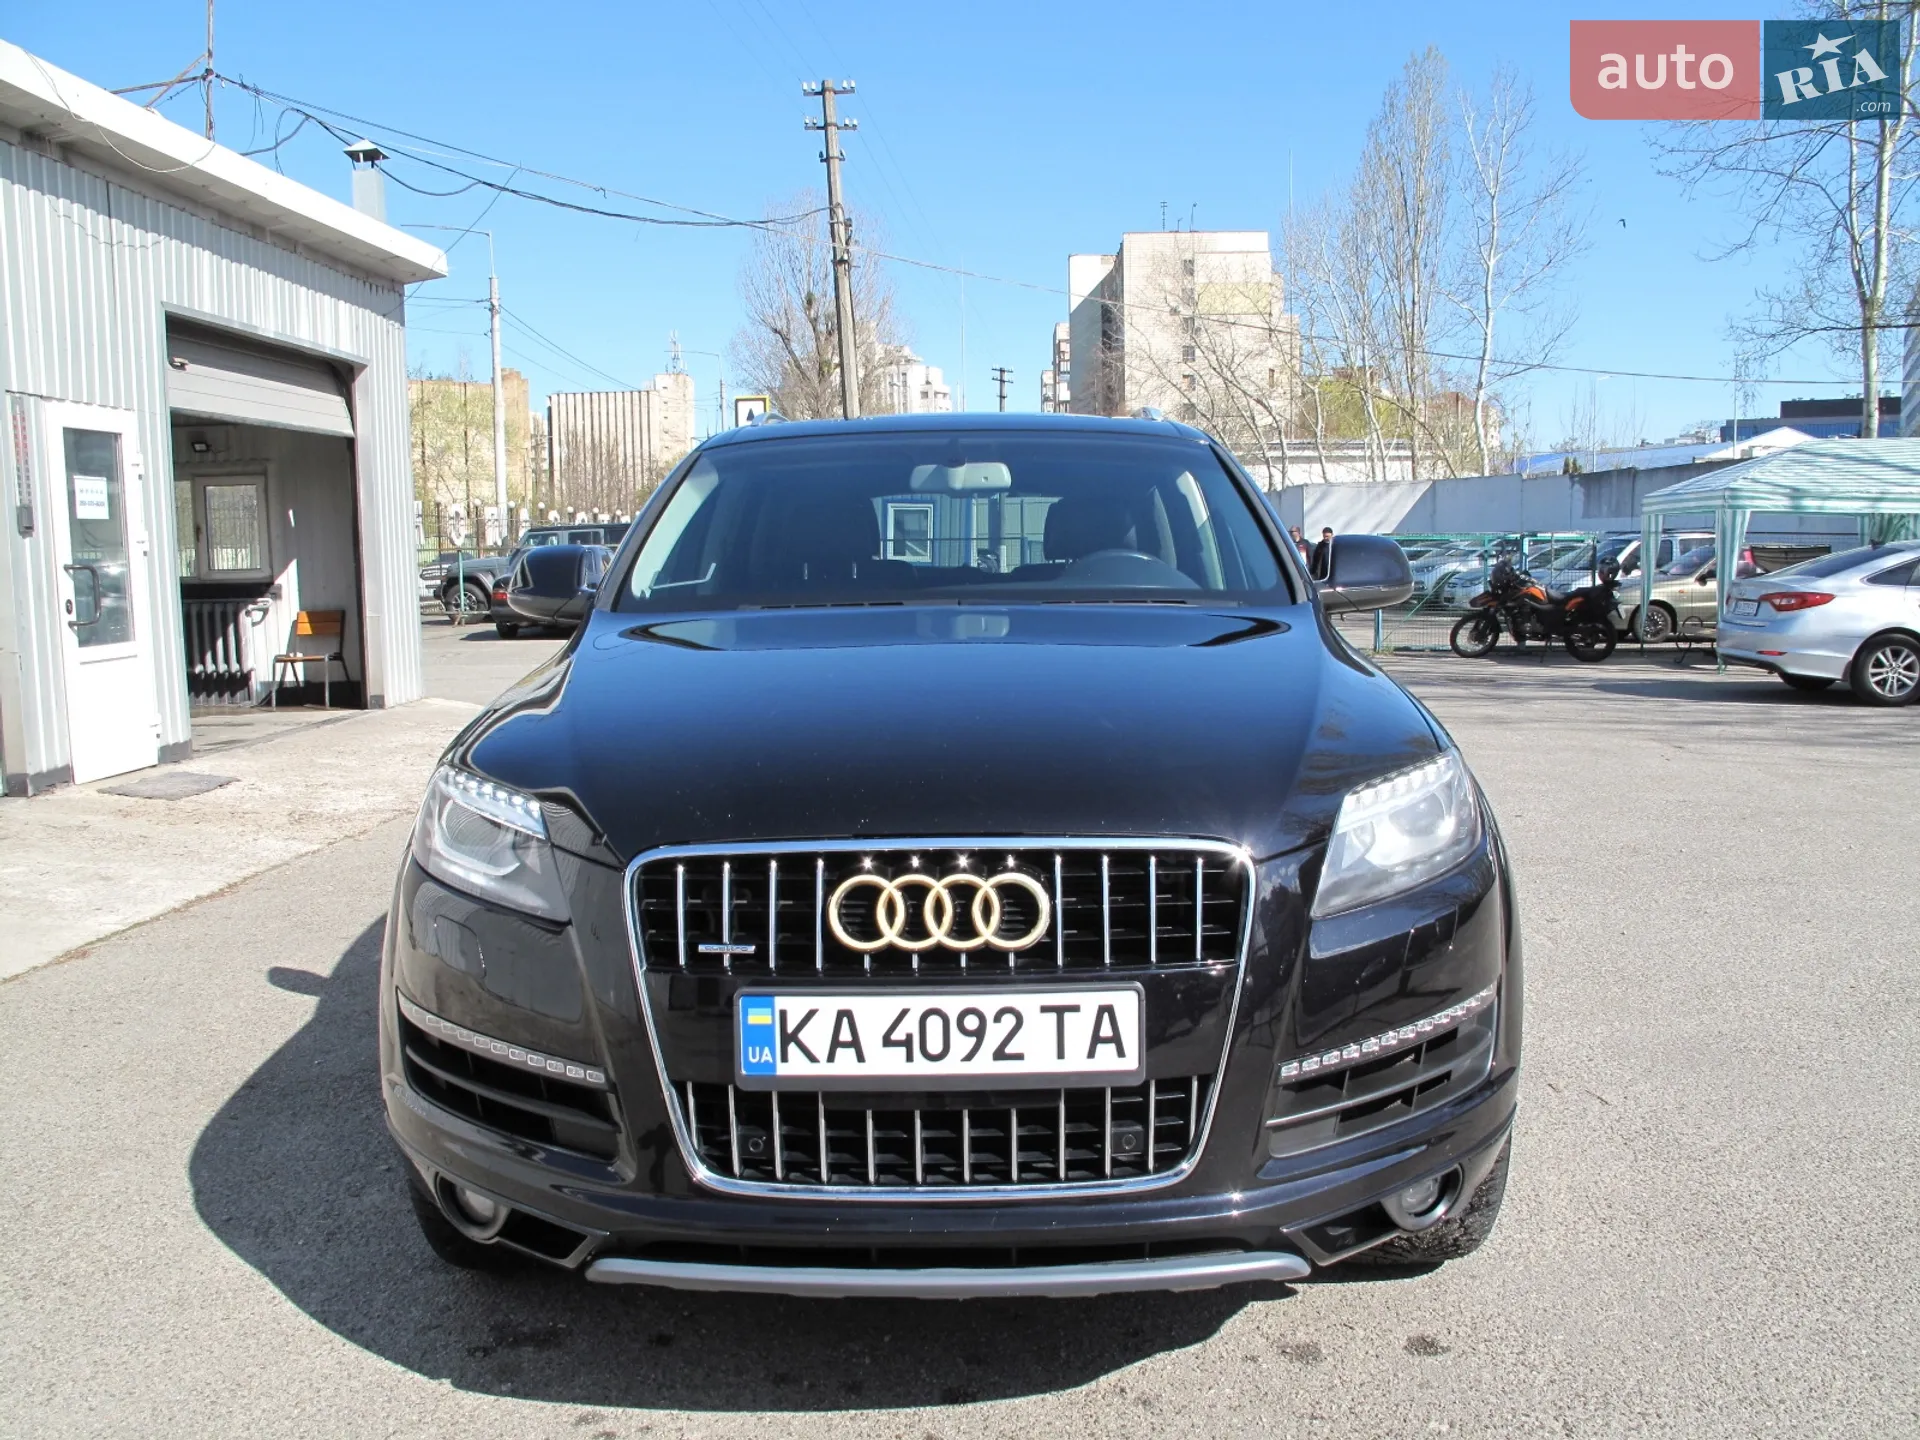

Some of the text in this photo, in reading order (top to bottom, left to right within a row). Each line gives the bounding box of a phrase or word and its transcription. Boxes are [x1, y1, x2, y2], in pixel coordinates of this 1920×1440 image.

[779, 1004, 1126, 1064] KA 4092 TA
[748, 1046, 773, 1063] UA
